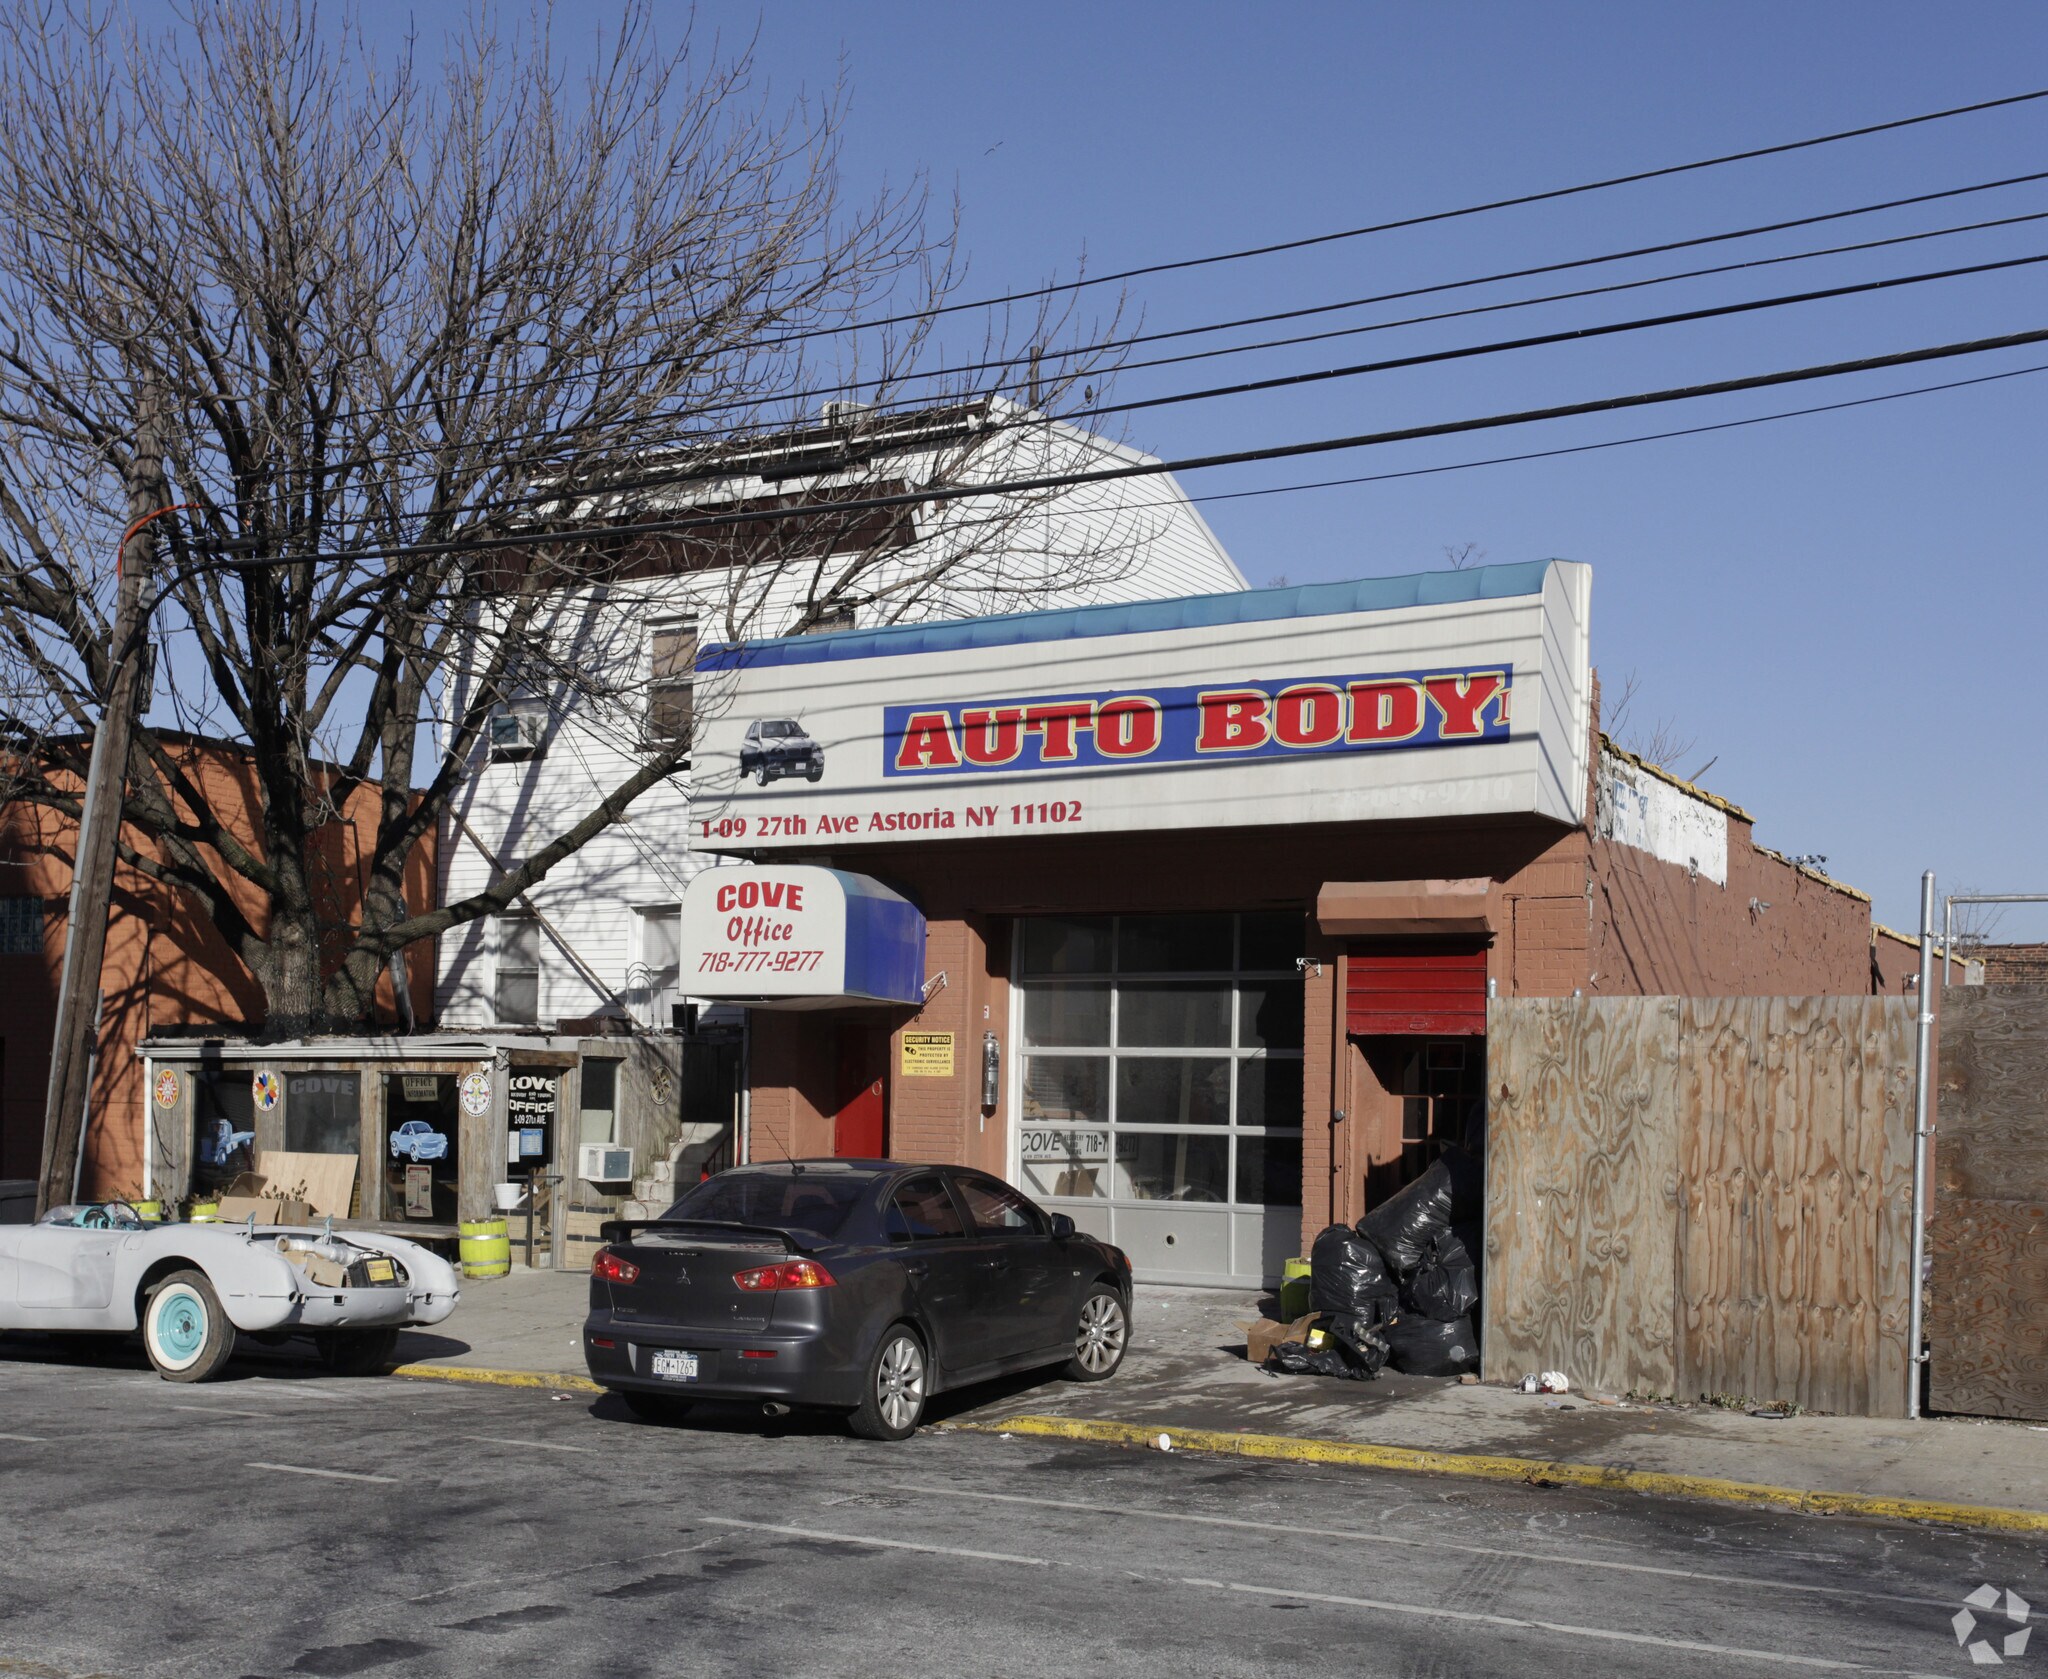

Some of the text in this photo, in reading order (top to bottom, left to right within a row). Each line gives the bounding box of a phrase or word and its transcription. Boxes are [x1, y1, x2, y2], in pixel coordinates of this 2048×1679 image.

[895, 695, 1162, 770] AUTO
[1195, 671, 1505, 753] BODY
[701, 801, 1082, 839] 1-09 27th Ave Astoria NY 11102
[717, 881, 804, 912] COVE
[727, 915, 793, 947] Office
[698, 951, 824, 972] 718-777-9277
[289, 1077, 354, 1096] COVE
[405, 1077, 433, 1087] OFFICE
[509, 1076, 555, 1093] COVE
[406, 1089, 436, 1098] INFORMATION
[509, 1099, 555, 1113] OFFICE
[1022, 1132, 1062, 1152] COVE
